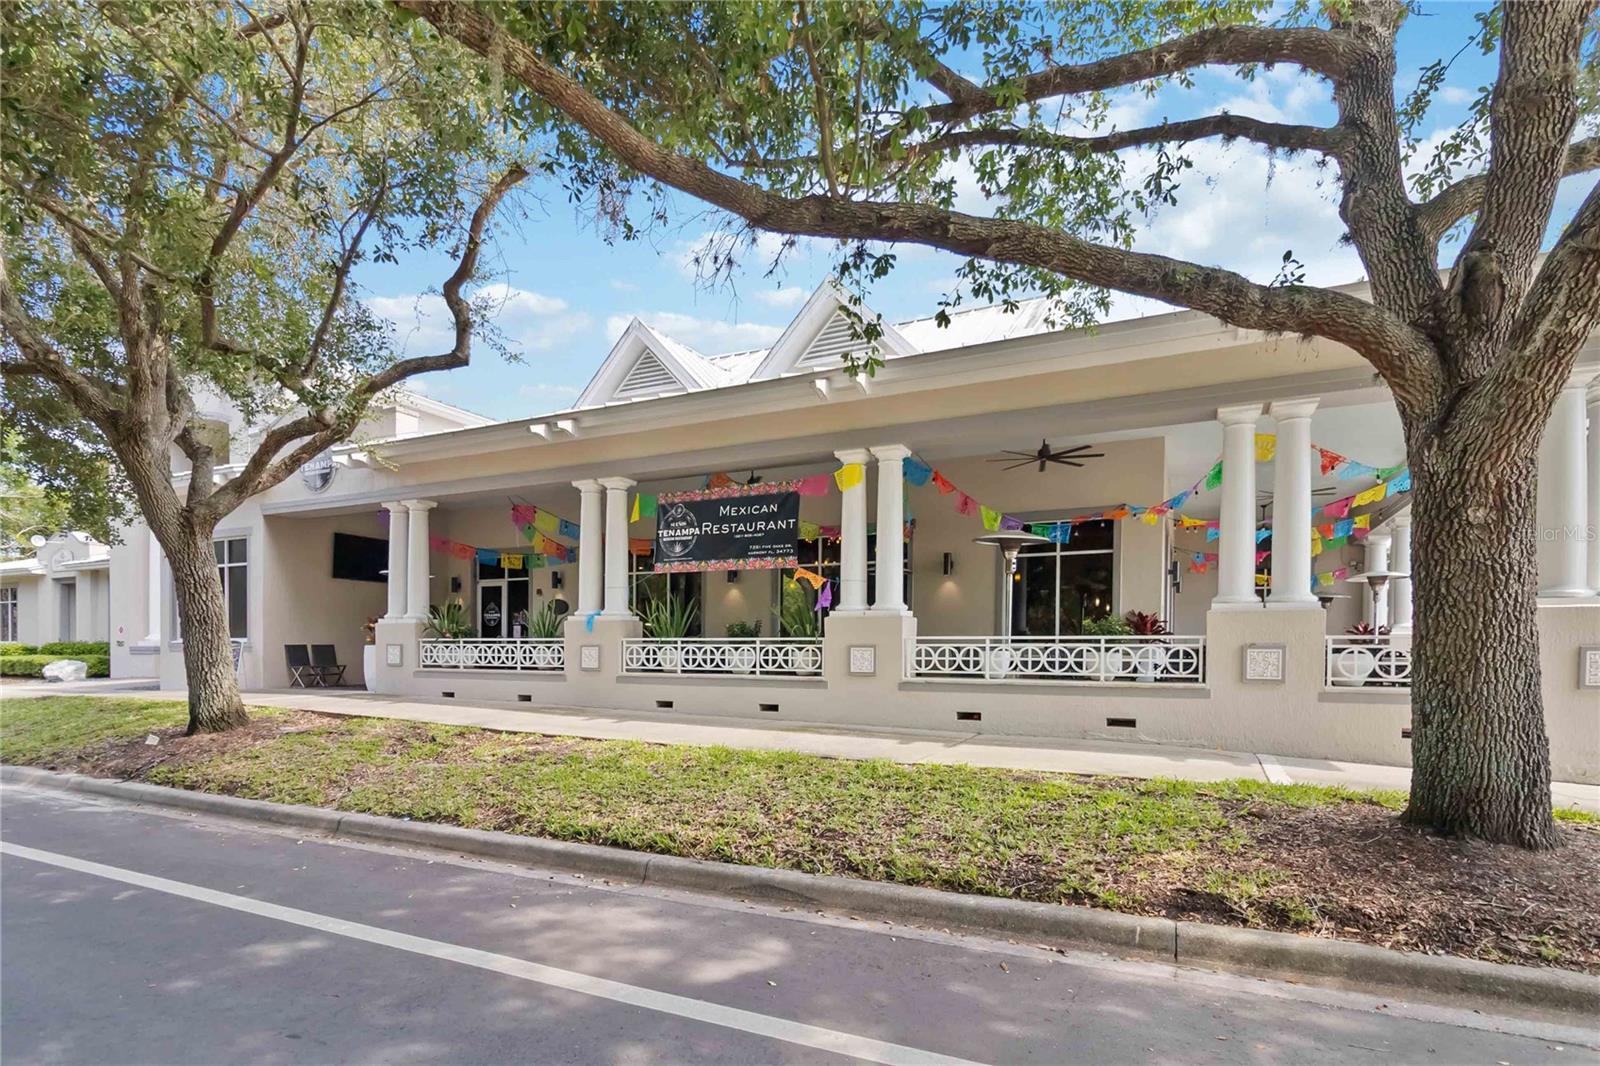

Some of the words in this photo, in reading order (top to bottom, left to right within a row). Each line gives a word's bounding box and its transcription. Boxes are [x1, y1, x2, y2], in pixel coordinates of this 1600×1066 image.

[719, 503, 778, 517] MEXICAN
[657, 527, 700, 538] TENAMPA
[701, 519, 796, 535] RESTAURANT
